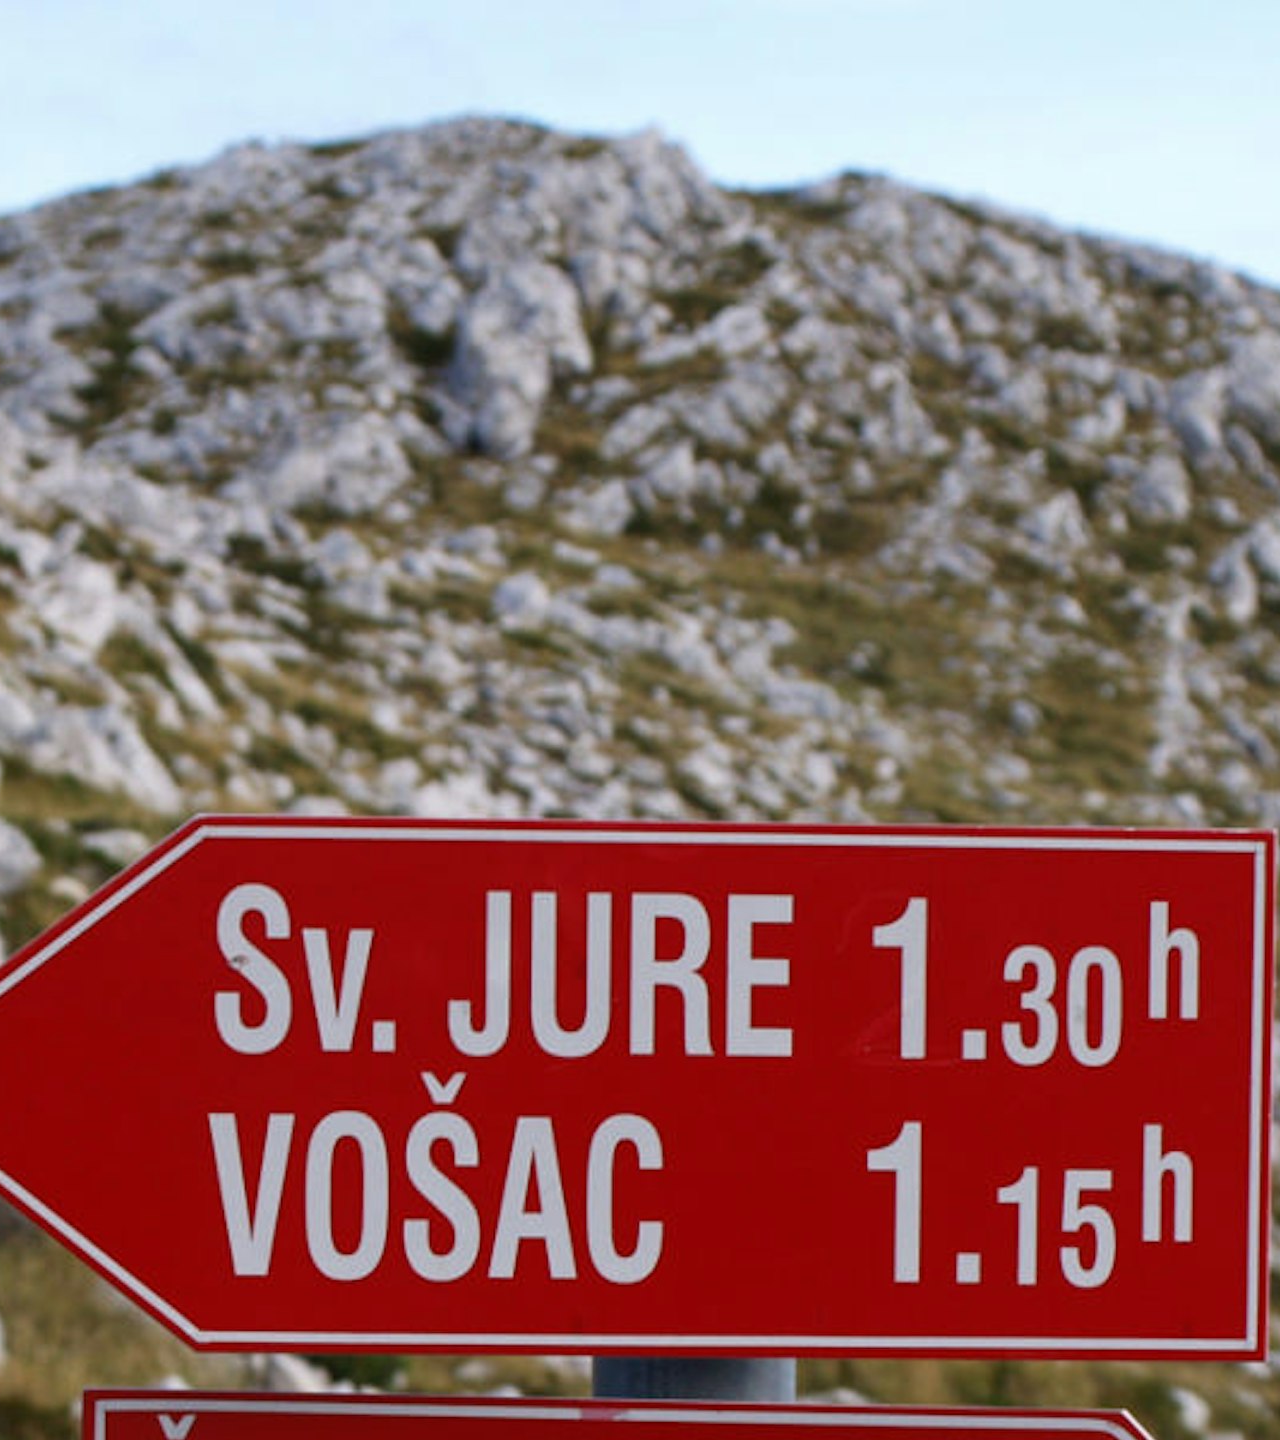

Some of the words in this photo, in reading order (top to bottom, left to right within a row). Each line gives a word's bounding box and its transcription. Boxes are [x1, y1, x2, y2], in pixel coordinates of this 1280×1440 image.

[214, 883, 396, 1056] Sv.
[448, 890, 794, 1060] JURE
[872, 896, 1122, 1068] 1.30
[208, 1072, 665, 1285] VOŠAC
[866, 1121, 1117, 1289] 1.15
